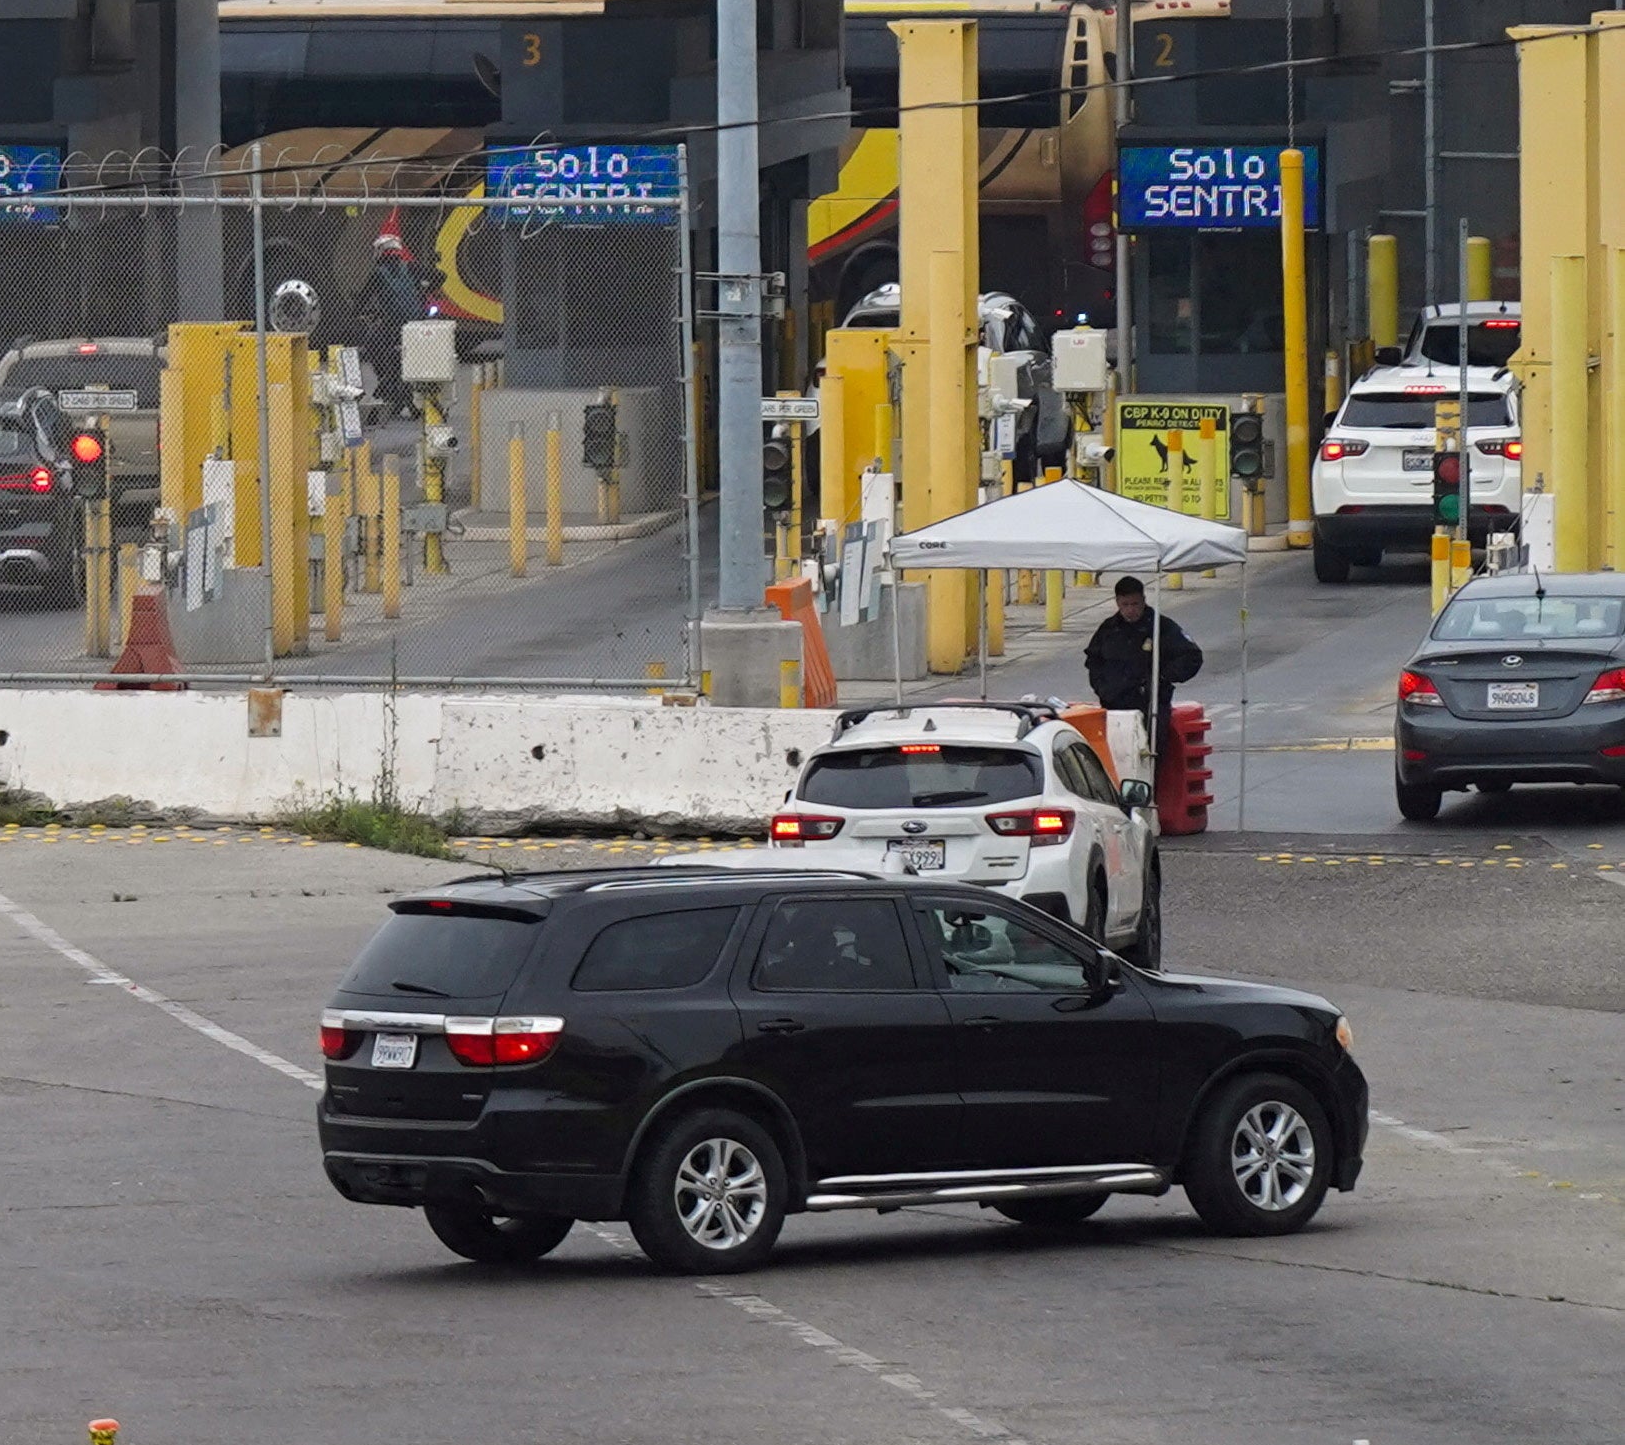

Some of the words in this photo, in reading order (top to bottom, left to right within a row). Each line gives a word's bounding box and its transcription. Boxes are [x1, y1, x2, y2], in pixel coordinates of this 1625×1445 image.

[523, 34, 542, 66] 3
[1154, 32, 1175, 68] 2
[535, 147, 629, 178] Solo
[1167, 148, 1266, 181] Solo
[1124, 407, 1149, 419] CBP
[1150, 407, 1170, 419] K-9
[1172, 407, 1189, 419] ON
[1191, 407, 1223, 420] DUTY
[919, 541, 947, 550] CORE
